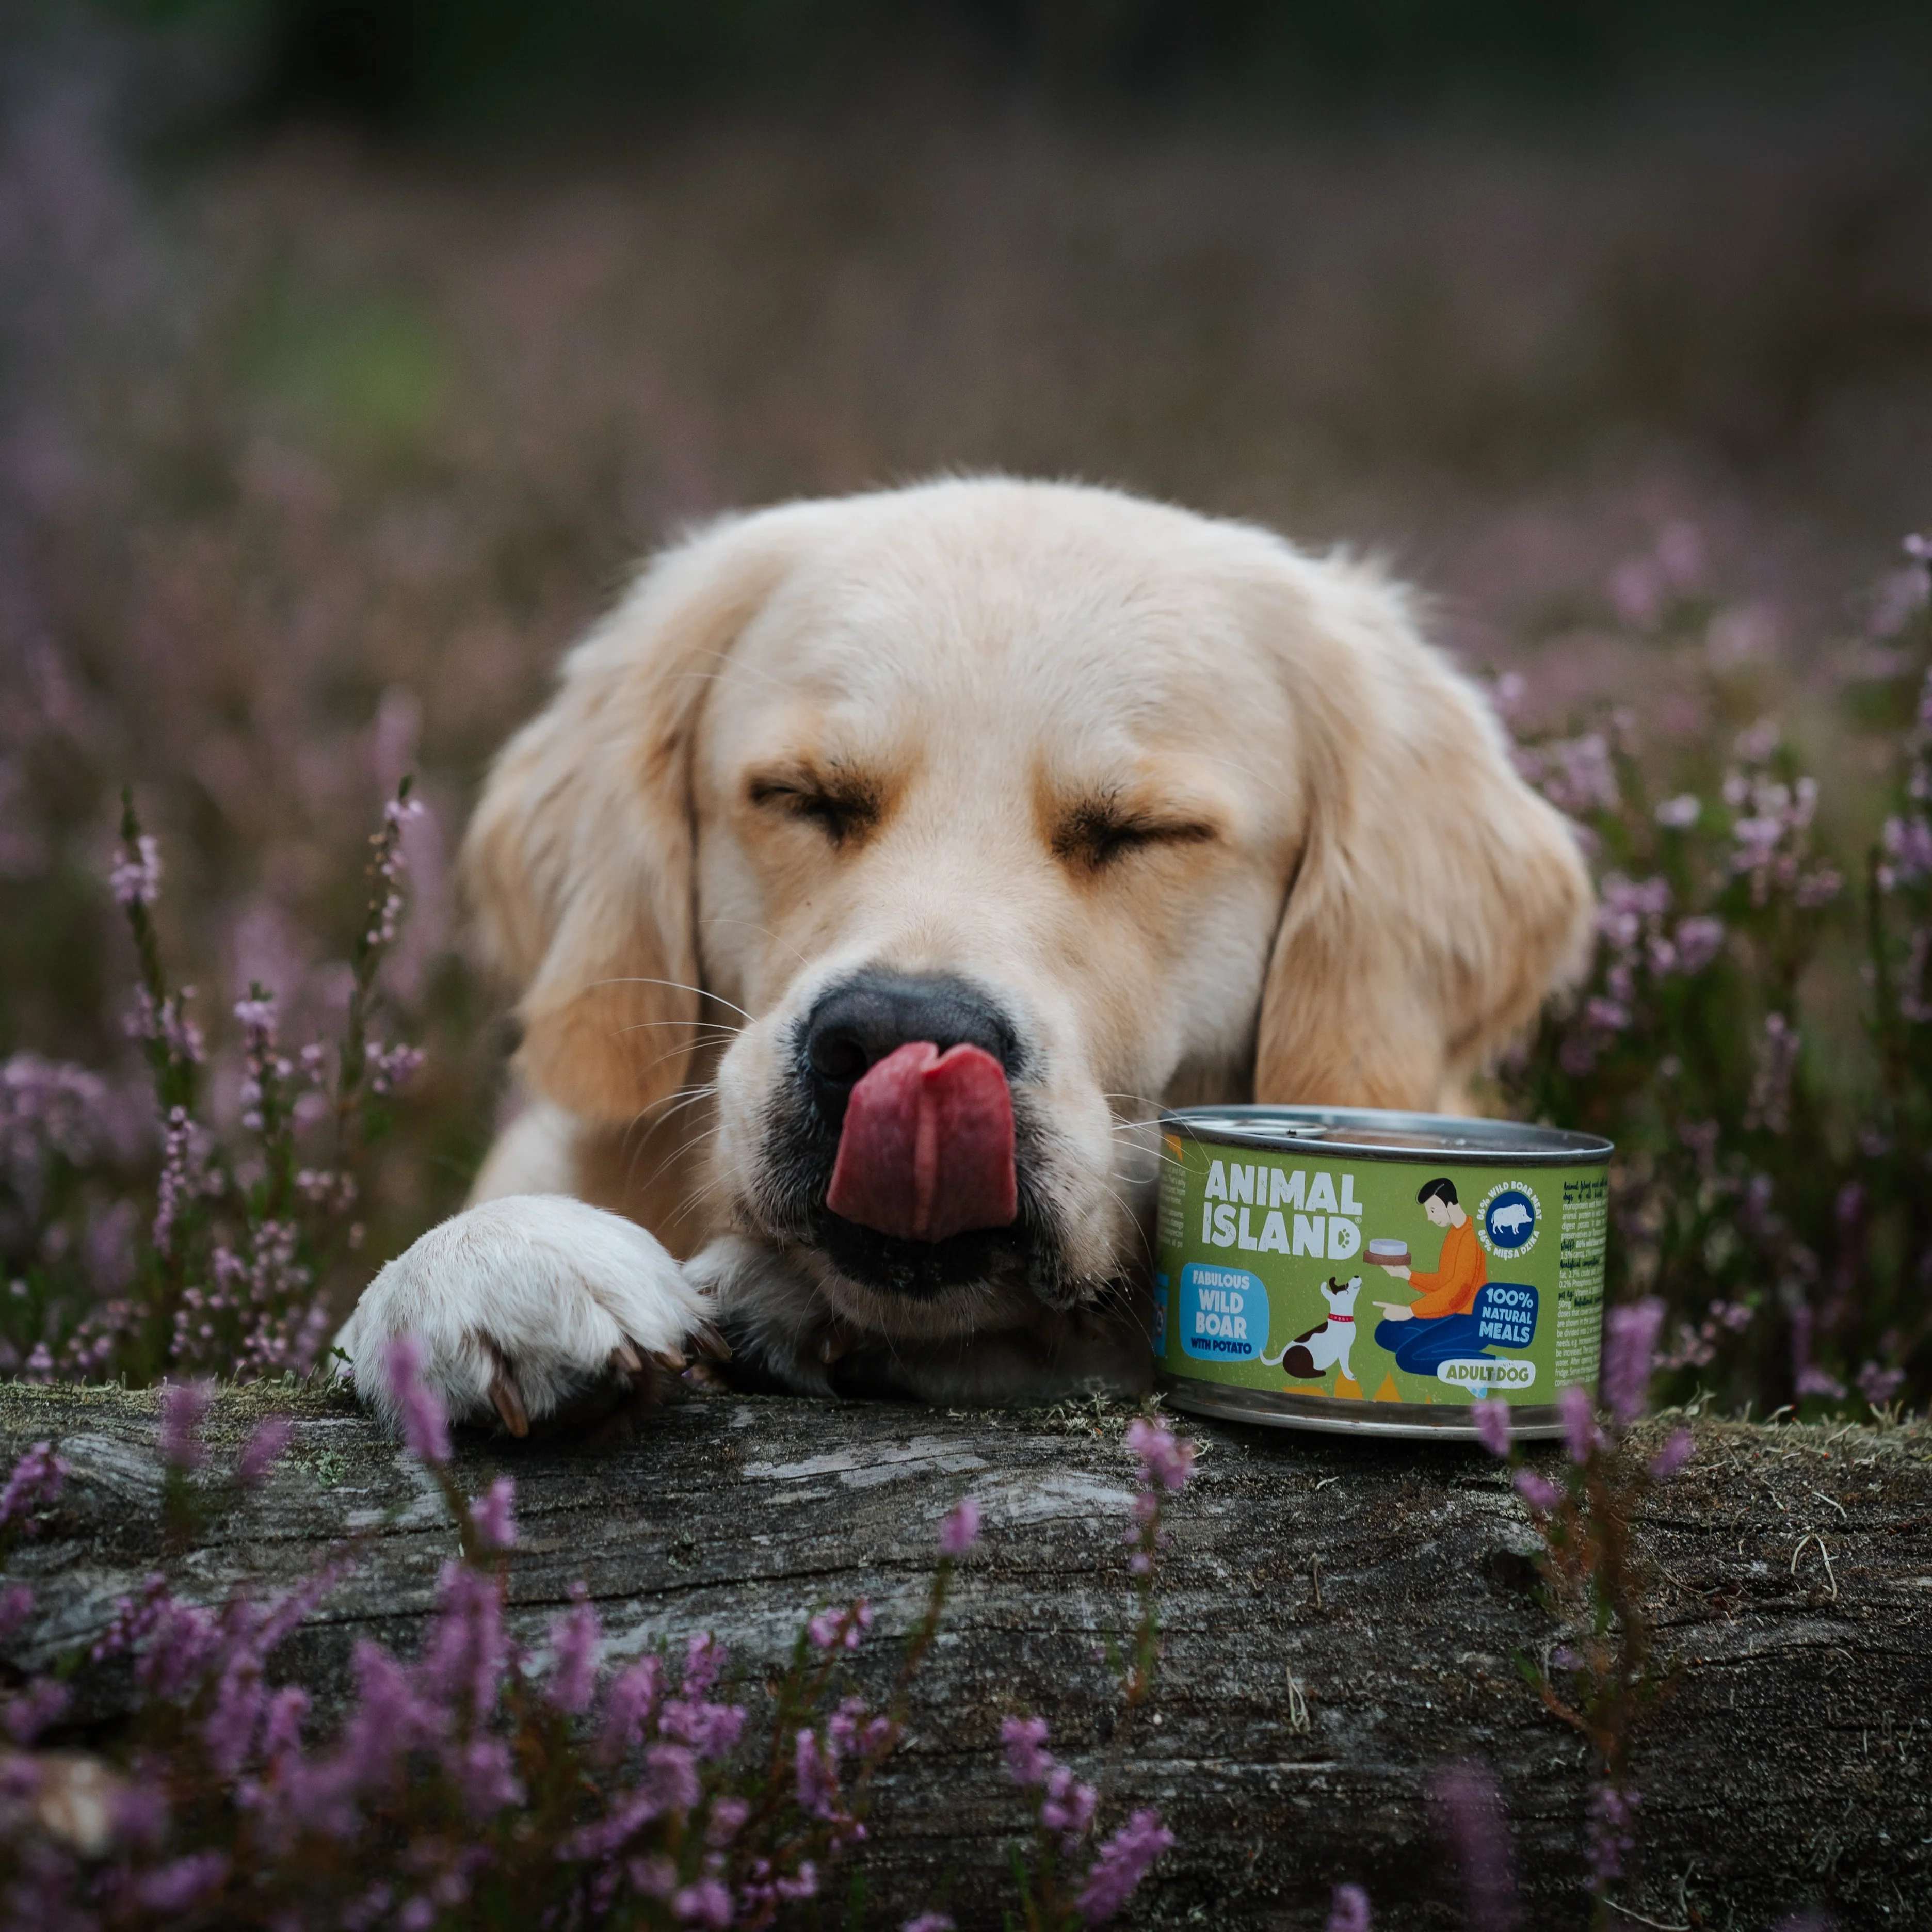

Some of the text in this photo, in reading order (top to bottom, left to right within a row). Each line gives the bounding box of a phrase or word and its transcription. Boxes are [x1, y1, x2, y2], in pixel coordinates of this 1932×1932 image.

[1205, 1160, 1362, 1215] ANIMAL
[1477, 1181, 1542, 1220] 86% WILD BOAR MEAT
[1562, 1211, 1577, 1220] animal
[1478, 1229, 1540, 1261] 86% MIĘSA DZIKA
[1193, 1270, 1250, 1290] FABULOUS
[1559, 1280, 1572, 1289] 0.2%
[1198, 1288, 1244, 1314] WILD
[1486, 1288, 1533, 1308] 100%
[1196, 1311, 1247, 1339] BOAR
[1482, 1307, 1532, 1324] NATURAL
[1479, 1321, 1530, 1343] MEALS
[1191, 1337, 1252, 1354] WITH POTATO
[1446, 1365, 1529, 1382] ADULT DOG
